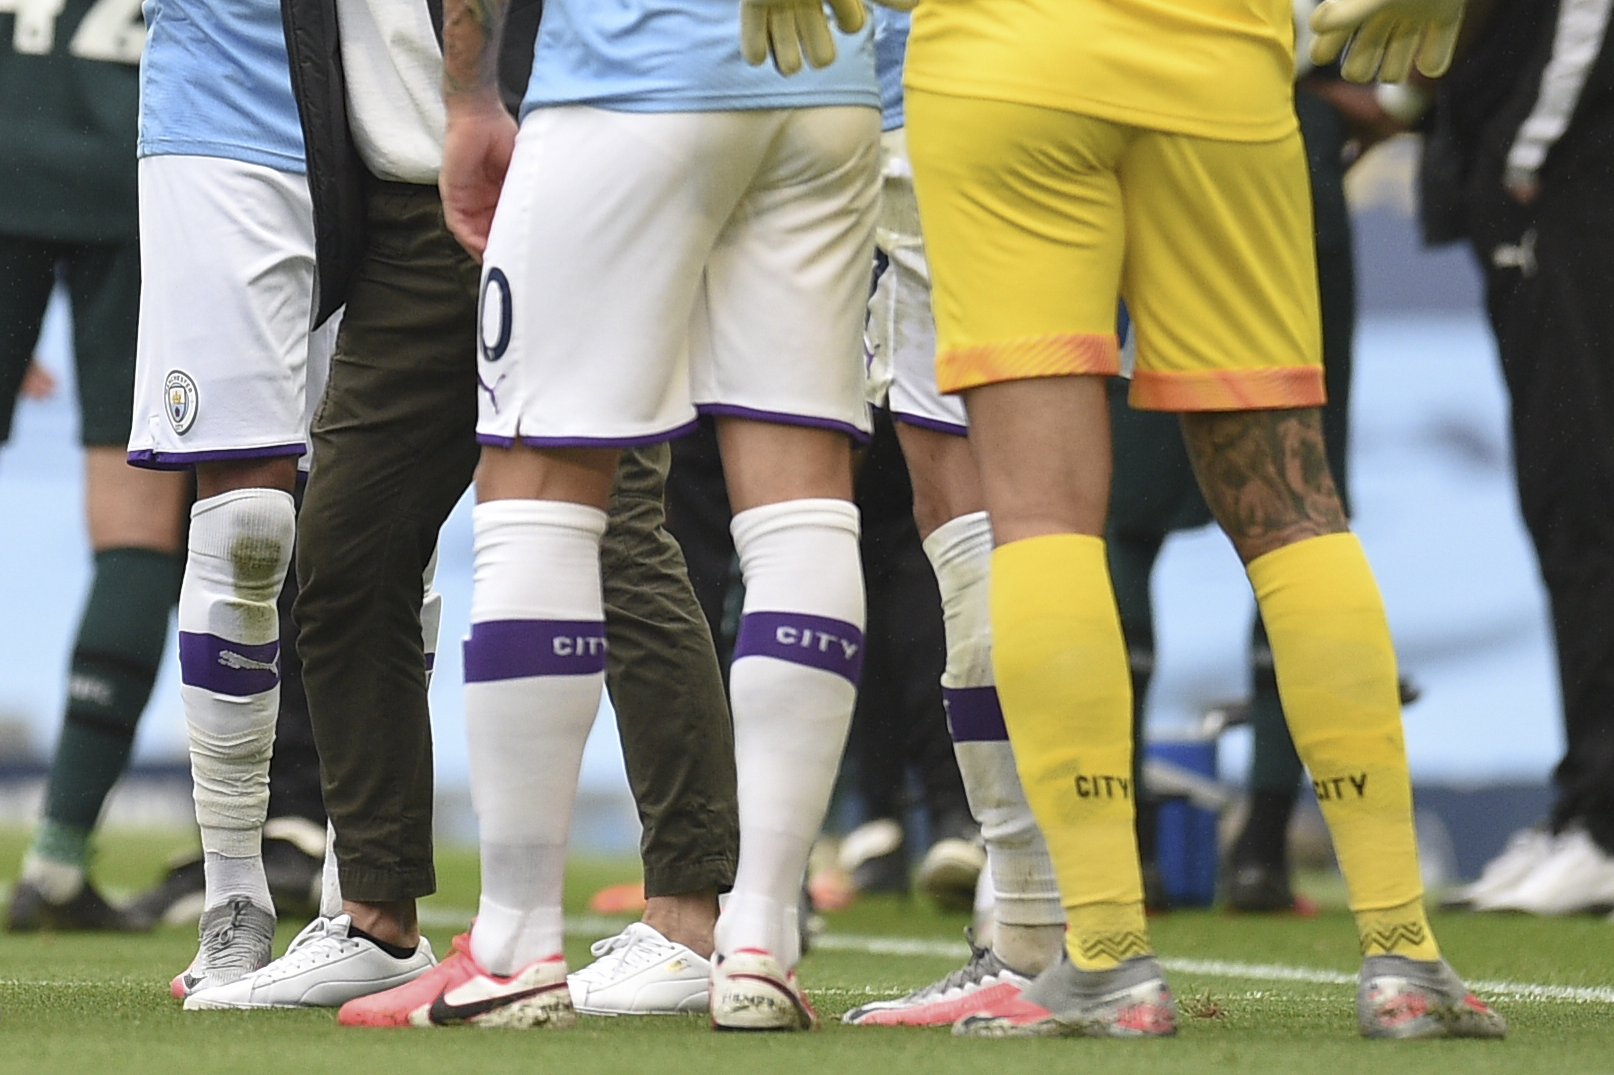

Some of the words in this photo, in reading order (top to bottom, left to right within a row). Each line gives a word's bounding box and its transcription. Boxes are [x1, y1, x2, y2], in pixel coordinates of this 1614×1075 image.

[479, 266, 513, 363] 0
[775, 625, 858, 661] CITY
[1074, 774, 1130, 800] CITY
